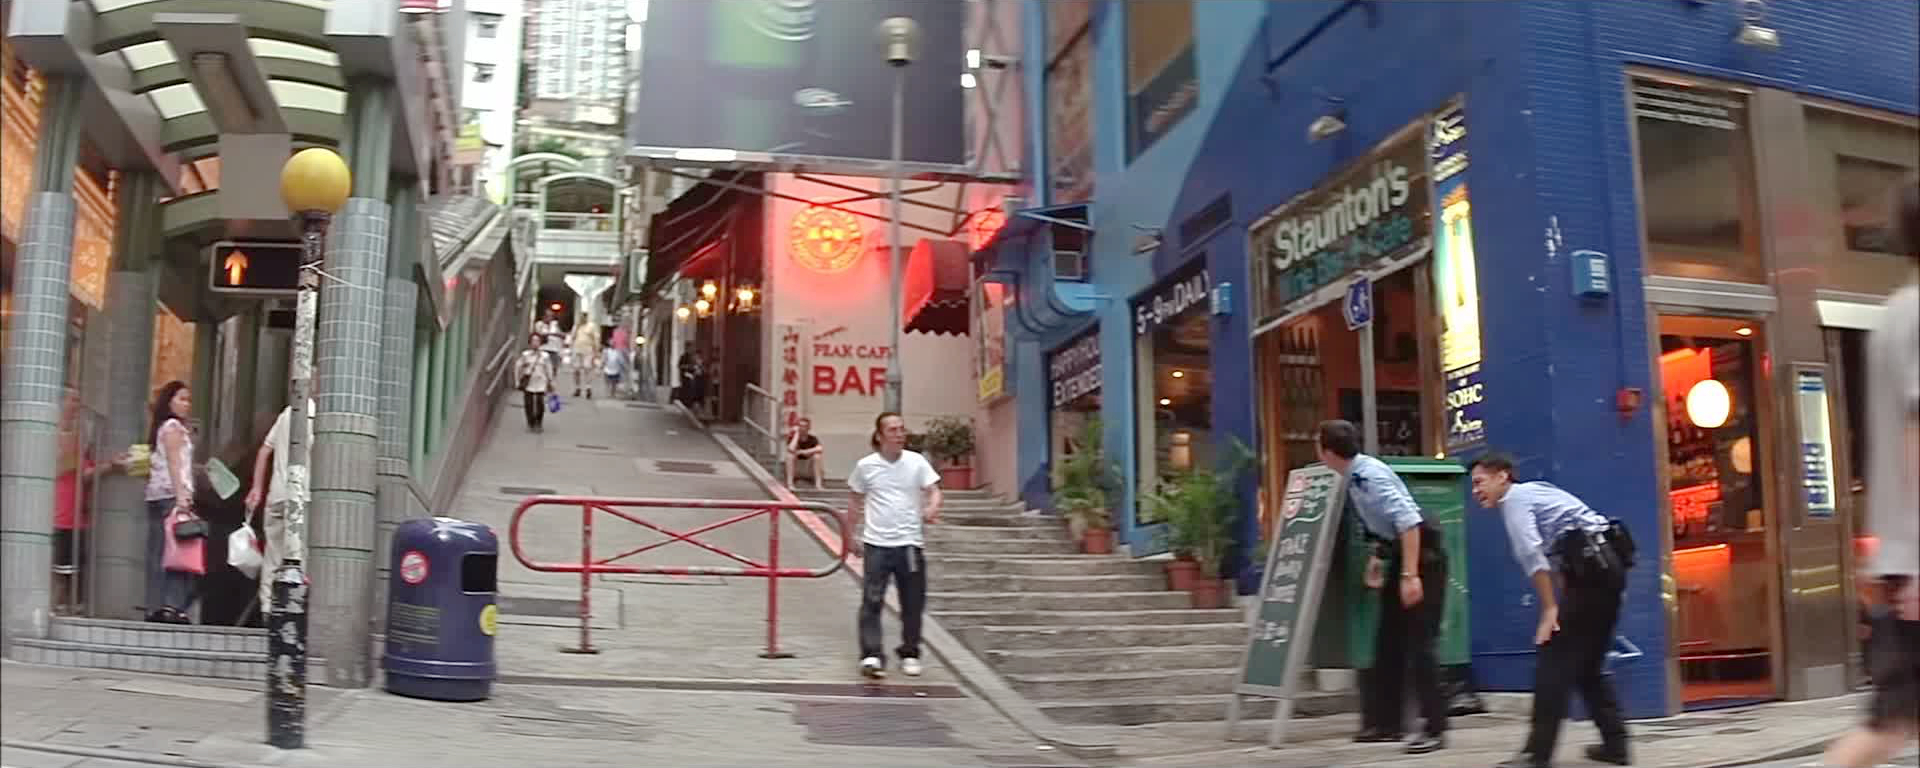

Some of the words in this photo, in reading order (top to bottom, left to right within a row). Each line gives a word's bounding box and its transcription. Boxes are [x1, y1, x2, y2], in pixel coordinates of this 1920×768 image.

[1274, 160, 1409, 269] Staunton's
[813, 343, 851, 358] PEAK
[856, 345, 891, 359] CAF
